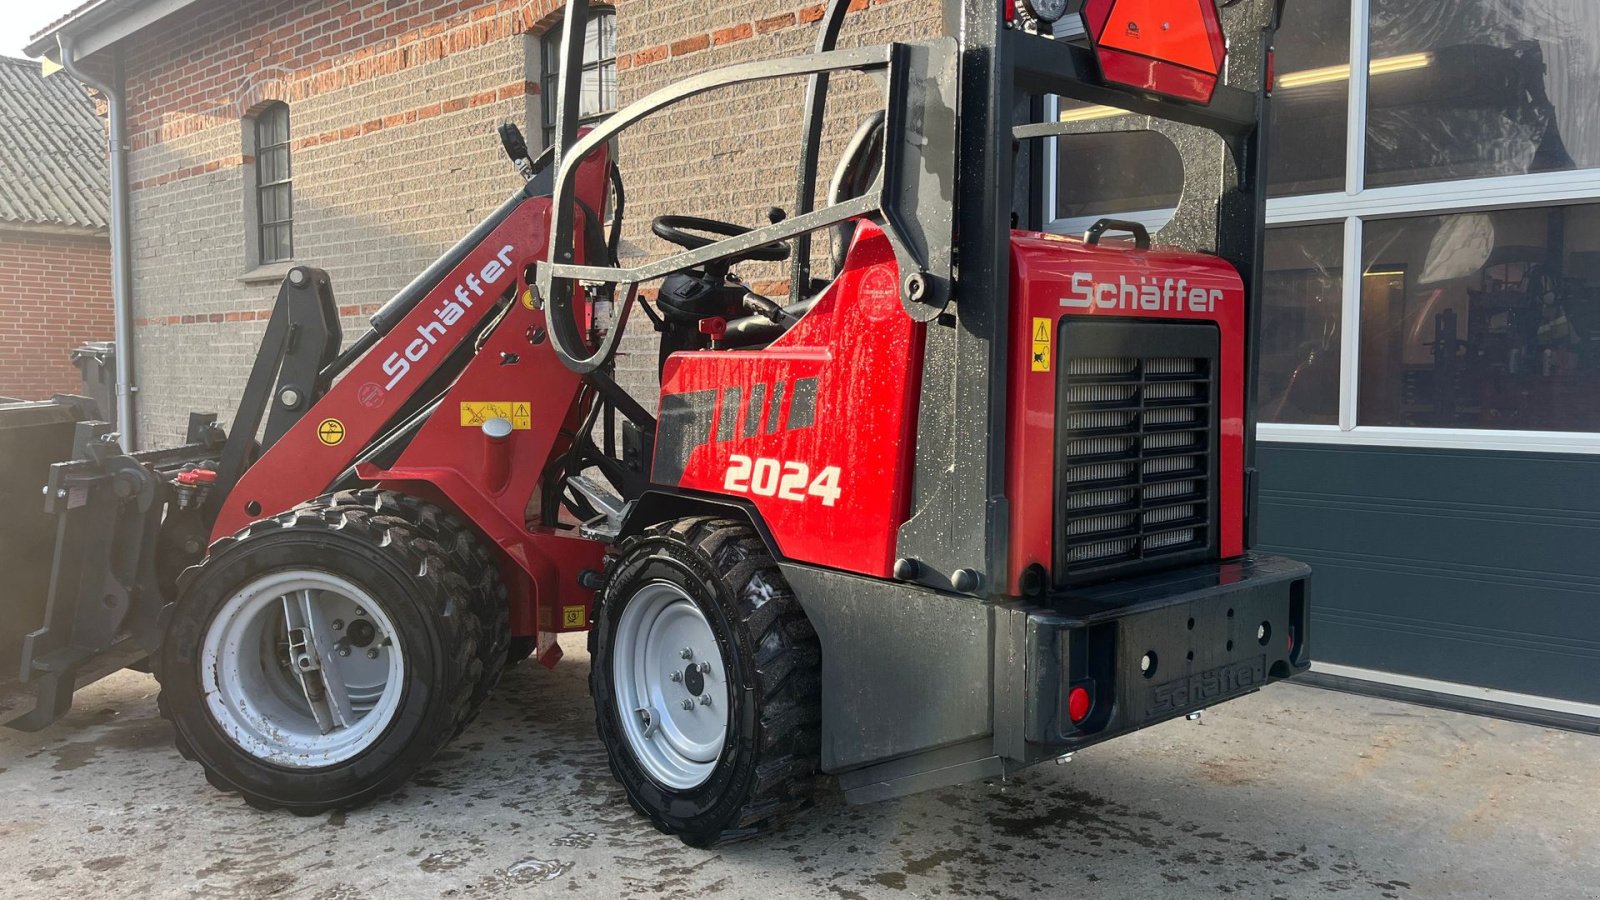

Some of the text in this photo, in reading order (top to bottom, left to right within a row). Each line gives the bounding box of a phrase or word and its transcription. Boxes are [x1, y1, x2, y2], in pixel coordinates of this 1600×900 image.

[382, 244, 514, 392] Schäffer
[1059, 272, 1224, 312] Schäffer
[723, 454, 842, 507] 2024
